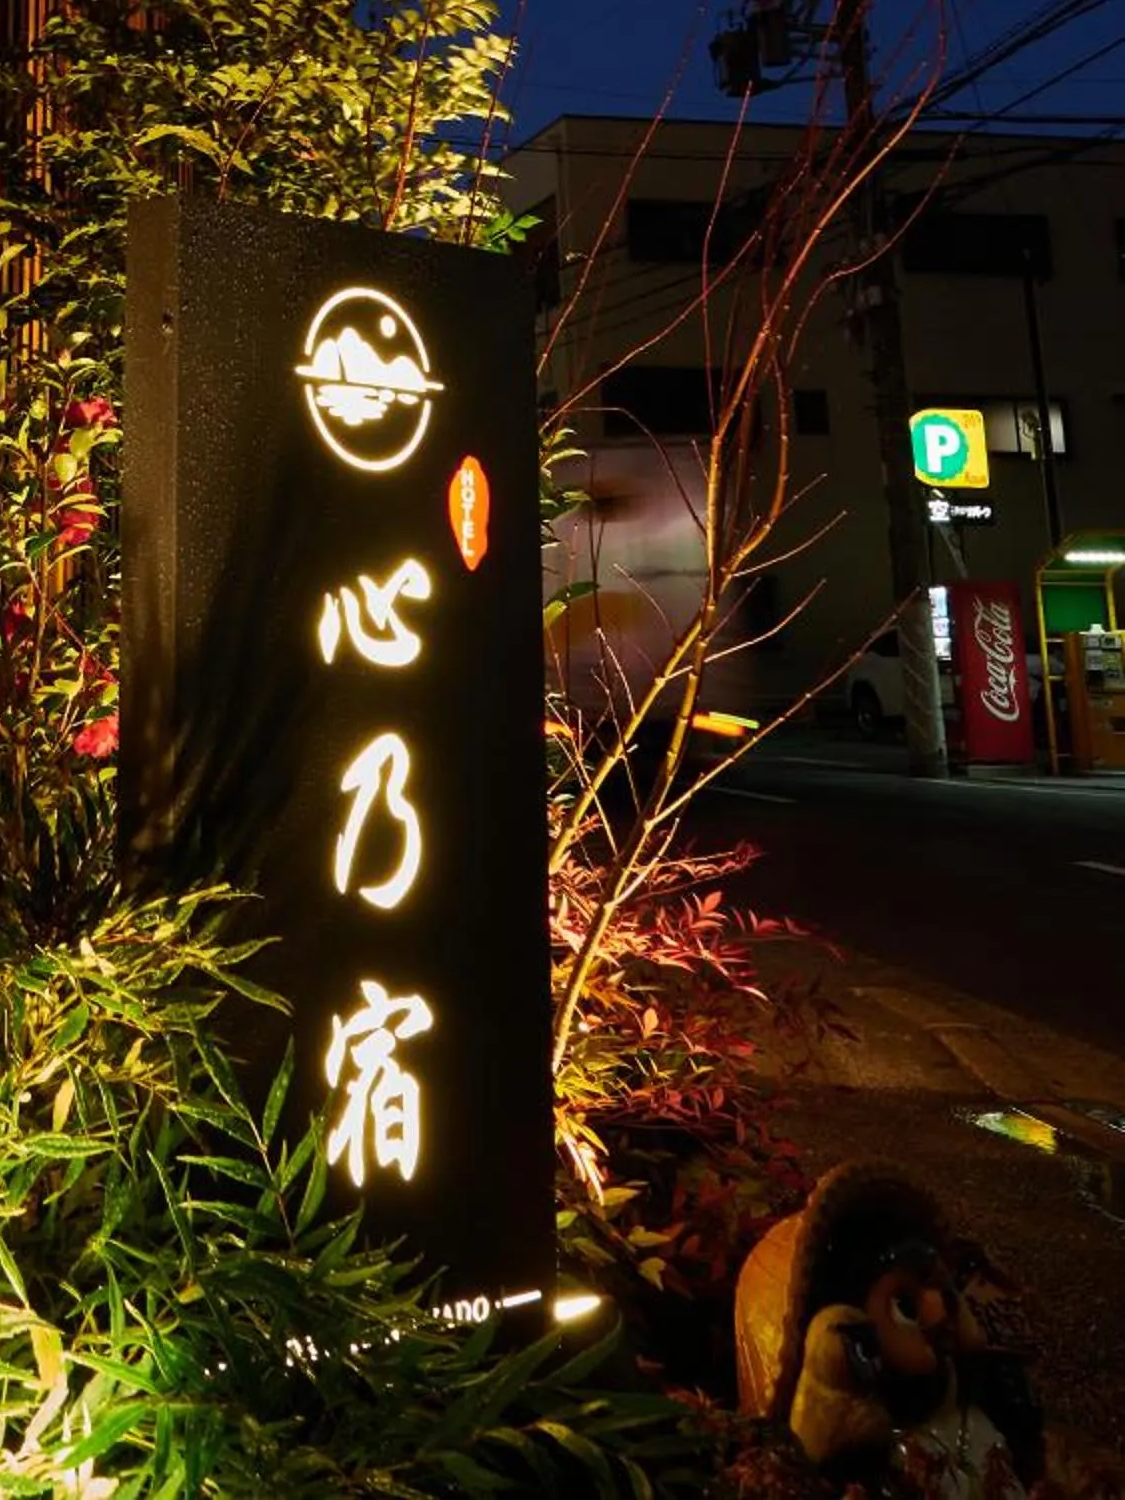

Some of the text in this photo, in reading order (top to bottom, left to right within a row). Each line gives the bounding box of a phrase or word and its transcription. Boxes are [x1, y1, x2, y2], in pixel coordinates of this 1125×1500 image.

[924, 425, 960, 473] P
[460, 468, 475, 557] HOTEL
[318, 558, 434, 1188] 心乃宿
